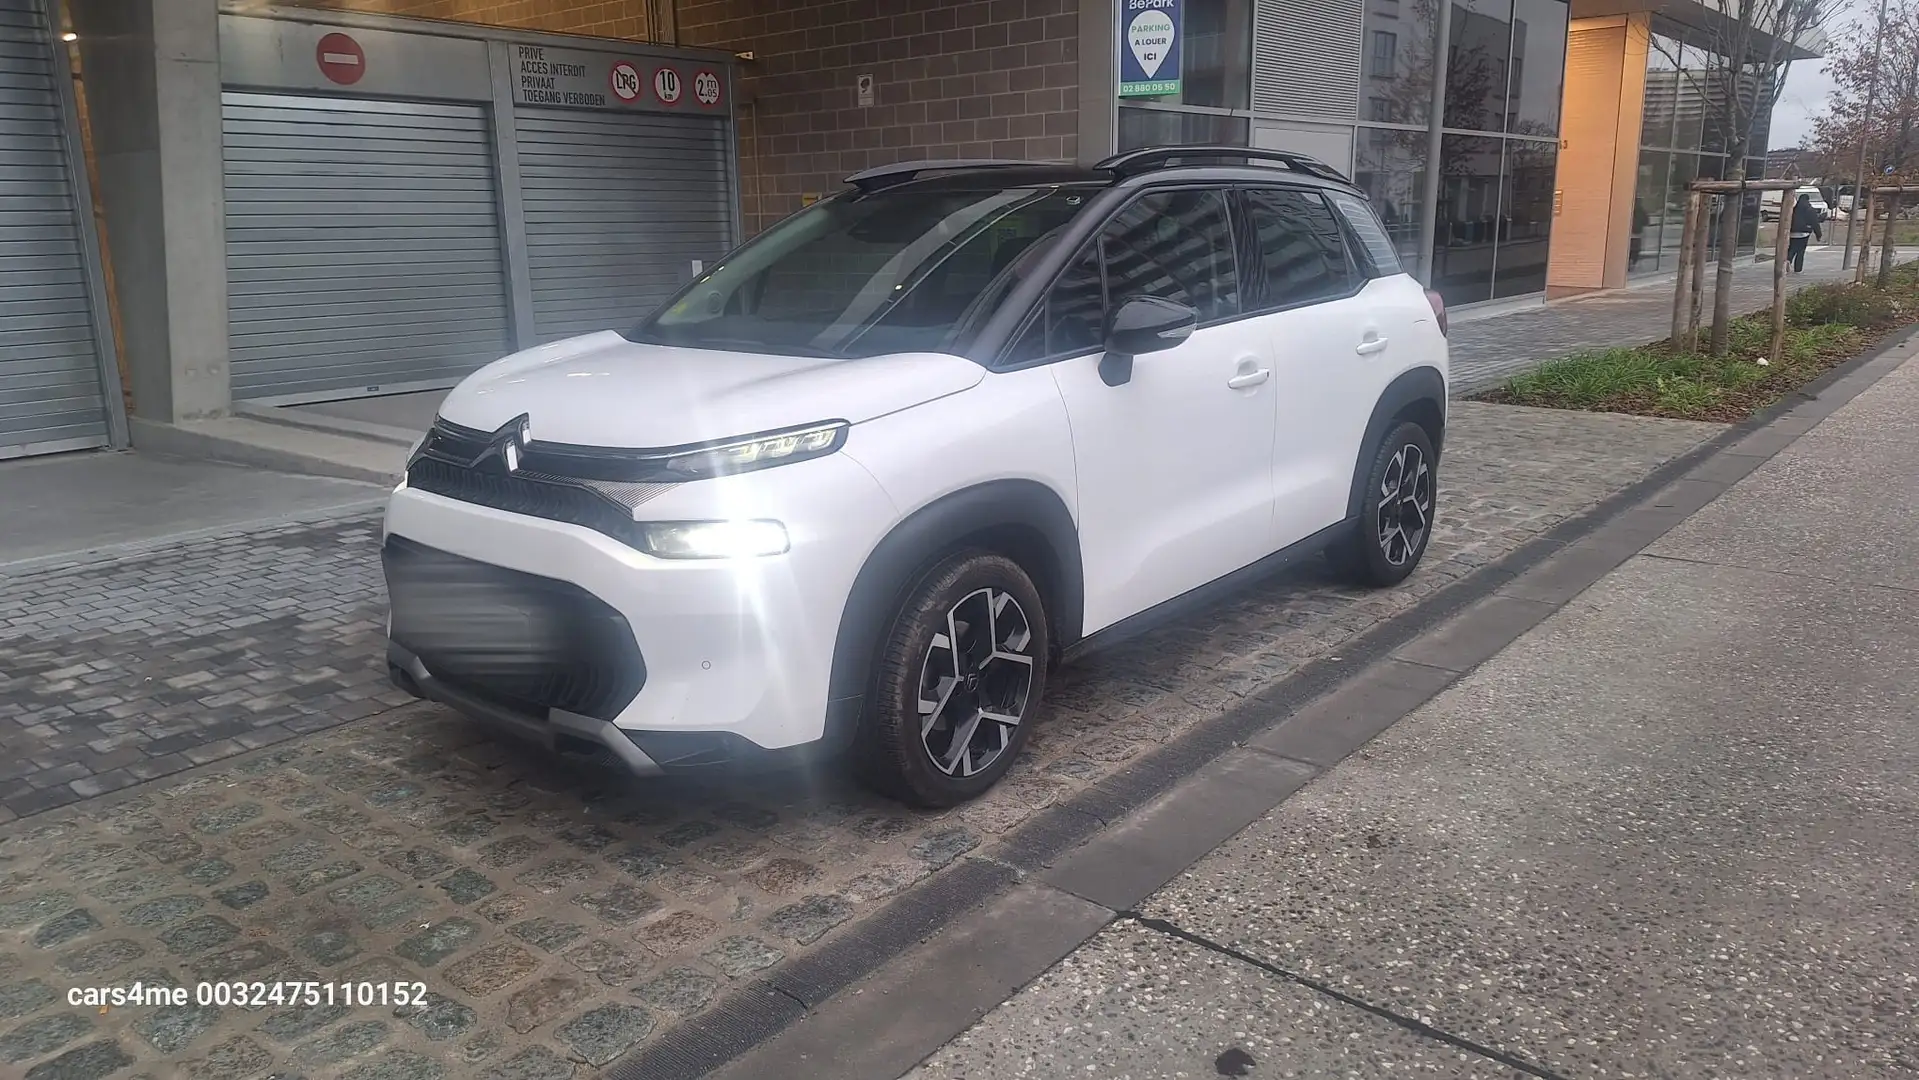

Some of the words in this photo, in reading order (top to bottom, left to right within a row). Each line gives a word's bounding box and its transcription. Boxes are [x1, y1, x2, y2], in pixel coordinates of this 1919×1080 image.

[1129, 0, 1174, 9] BePark
[1131, 24, 1171, 33] PARKING
[1142, 38, 1167, 46] LOUER
[518, 46, 544, 61] PRIVE
[1144, 53, 1157, 61] ICI
[521, 61, 548, 75] ACCES
[550, 63, 586, 78] INTERDIT
[521, 75, 555, 90] PRIVAAT
[660, 71, 675, 92] 10
[522, 89, 561, 104] TOEGANG
[563, 92, 606, 106] VERBODEN
[664, 92, 674, 100] km
